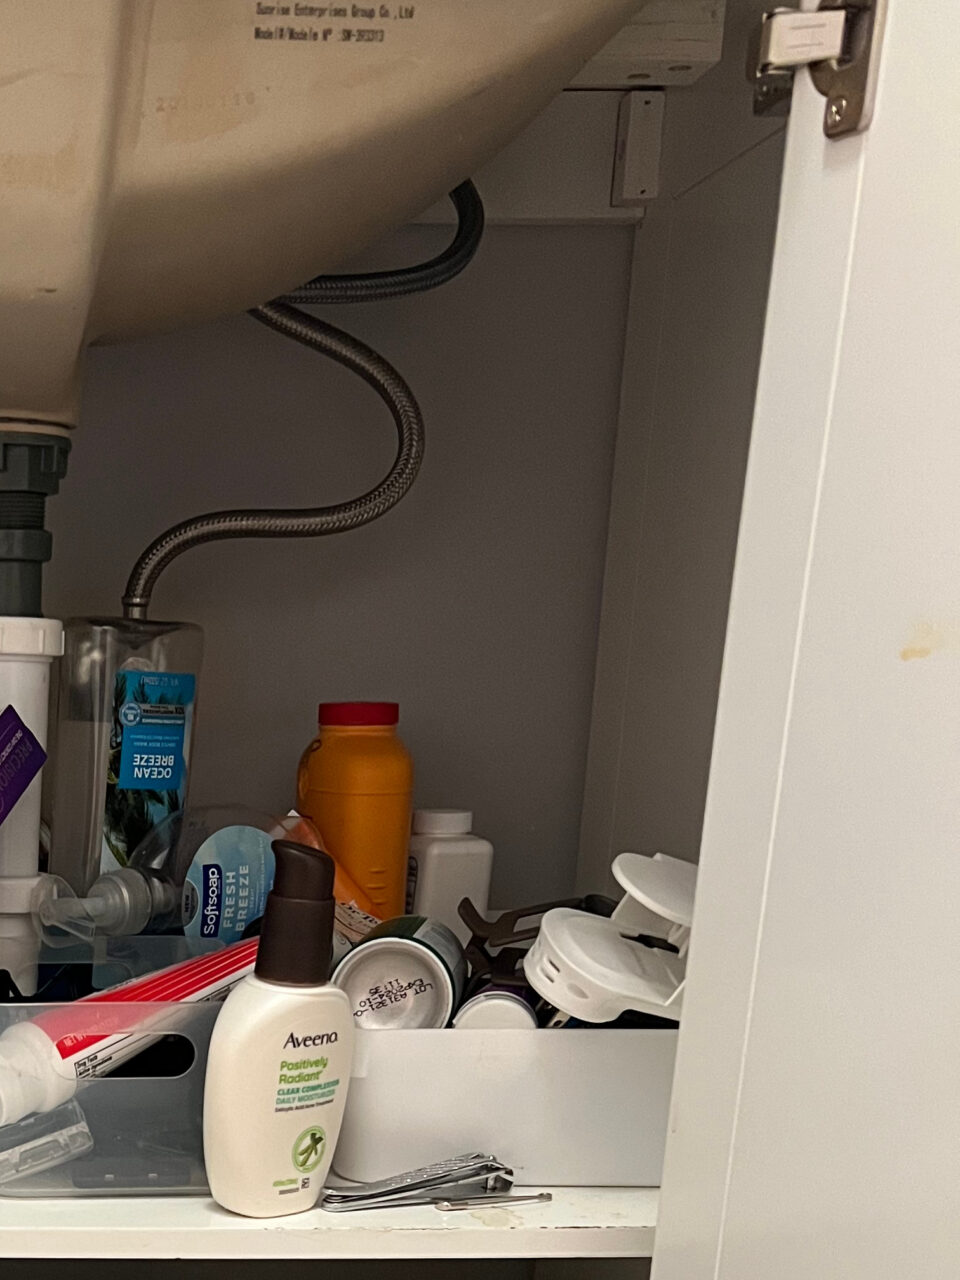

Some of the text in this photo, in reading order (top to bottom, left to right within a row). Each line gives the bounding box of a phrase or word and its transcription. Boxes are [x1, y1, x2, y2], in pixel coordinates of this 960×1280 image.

[256, 2, 290, 16] Sunrise
[294, 3, 347, 18] Enterprises
[351, 4, 376, 19] Group
[133, 754, 175, 766] BREEZE
[134, 767, 172, 779] OCEAN
[204, 868, 219, 934] Softsoap
[223, 872, 236, 928] FRESH
[235, 865, 249, 931] BREEZE
[414, 983, 433, 996] LOT
[283, 1031, 339, 1049] Aveeno
[280, 1056, 328, 1071] Positively
[279, 1070, 321, 1085] Radiant
[277, 1087, 300, 1096] CLEAR
[276, 1097, 297, 1105] DAILY
